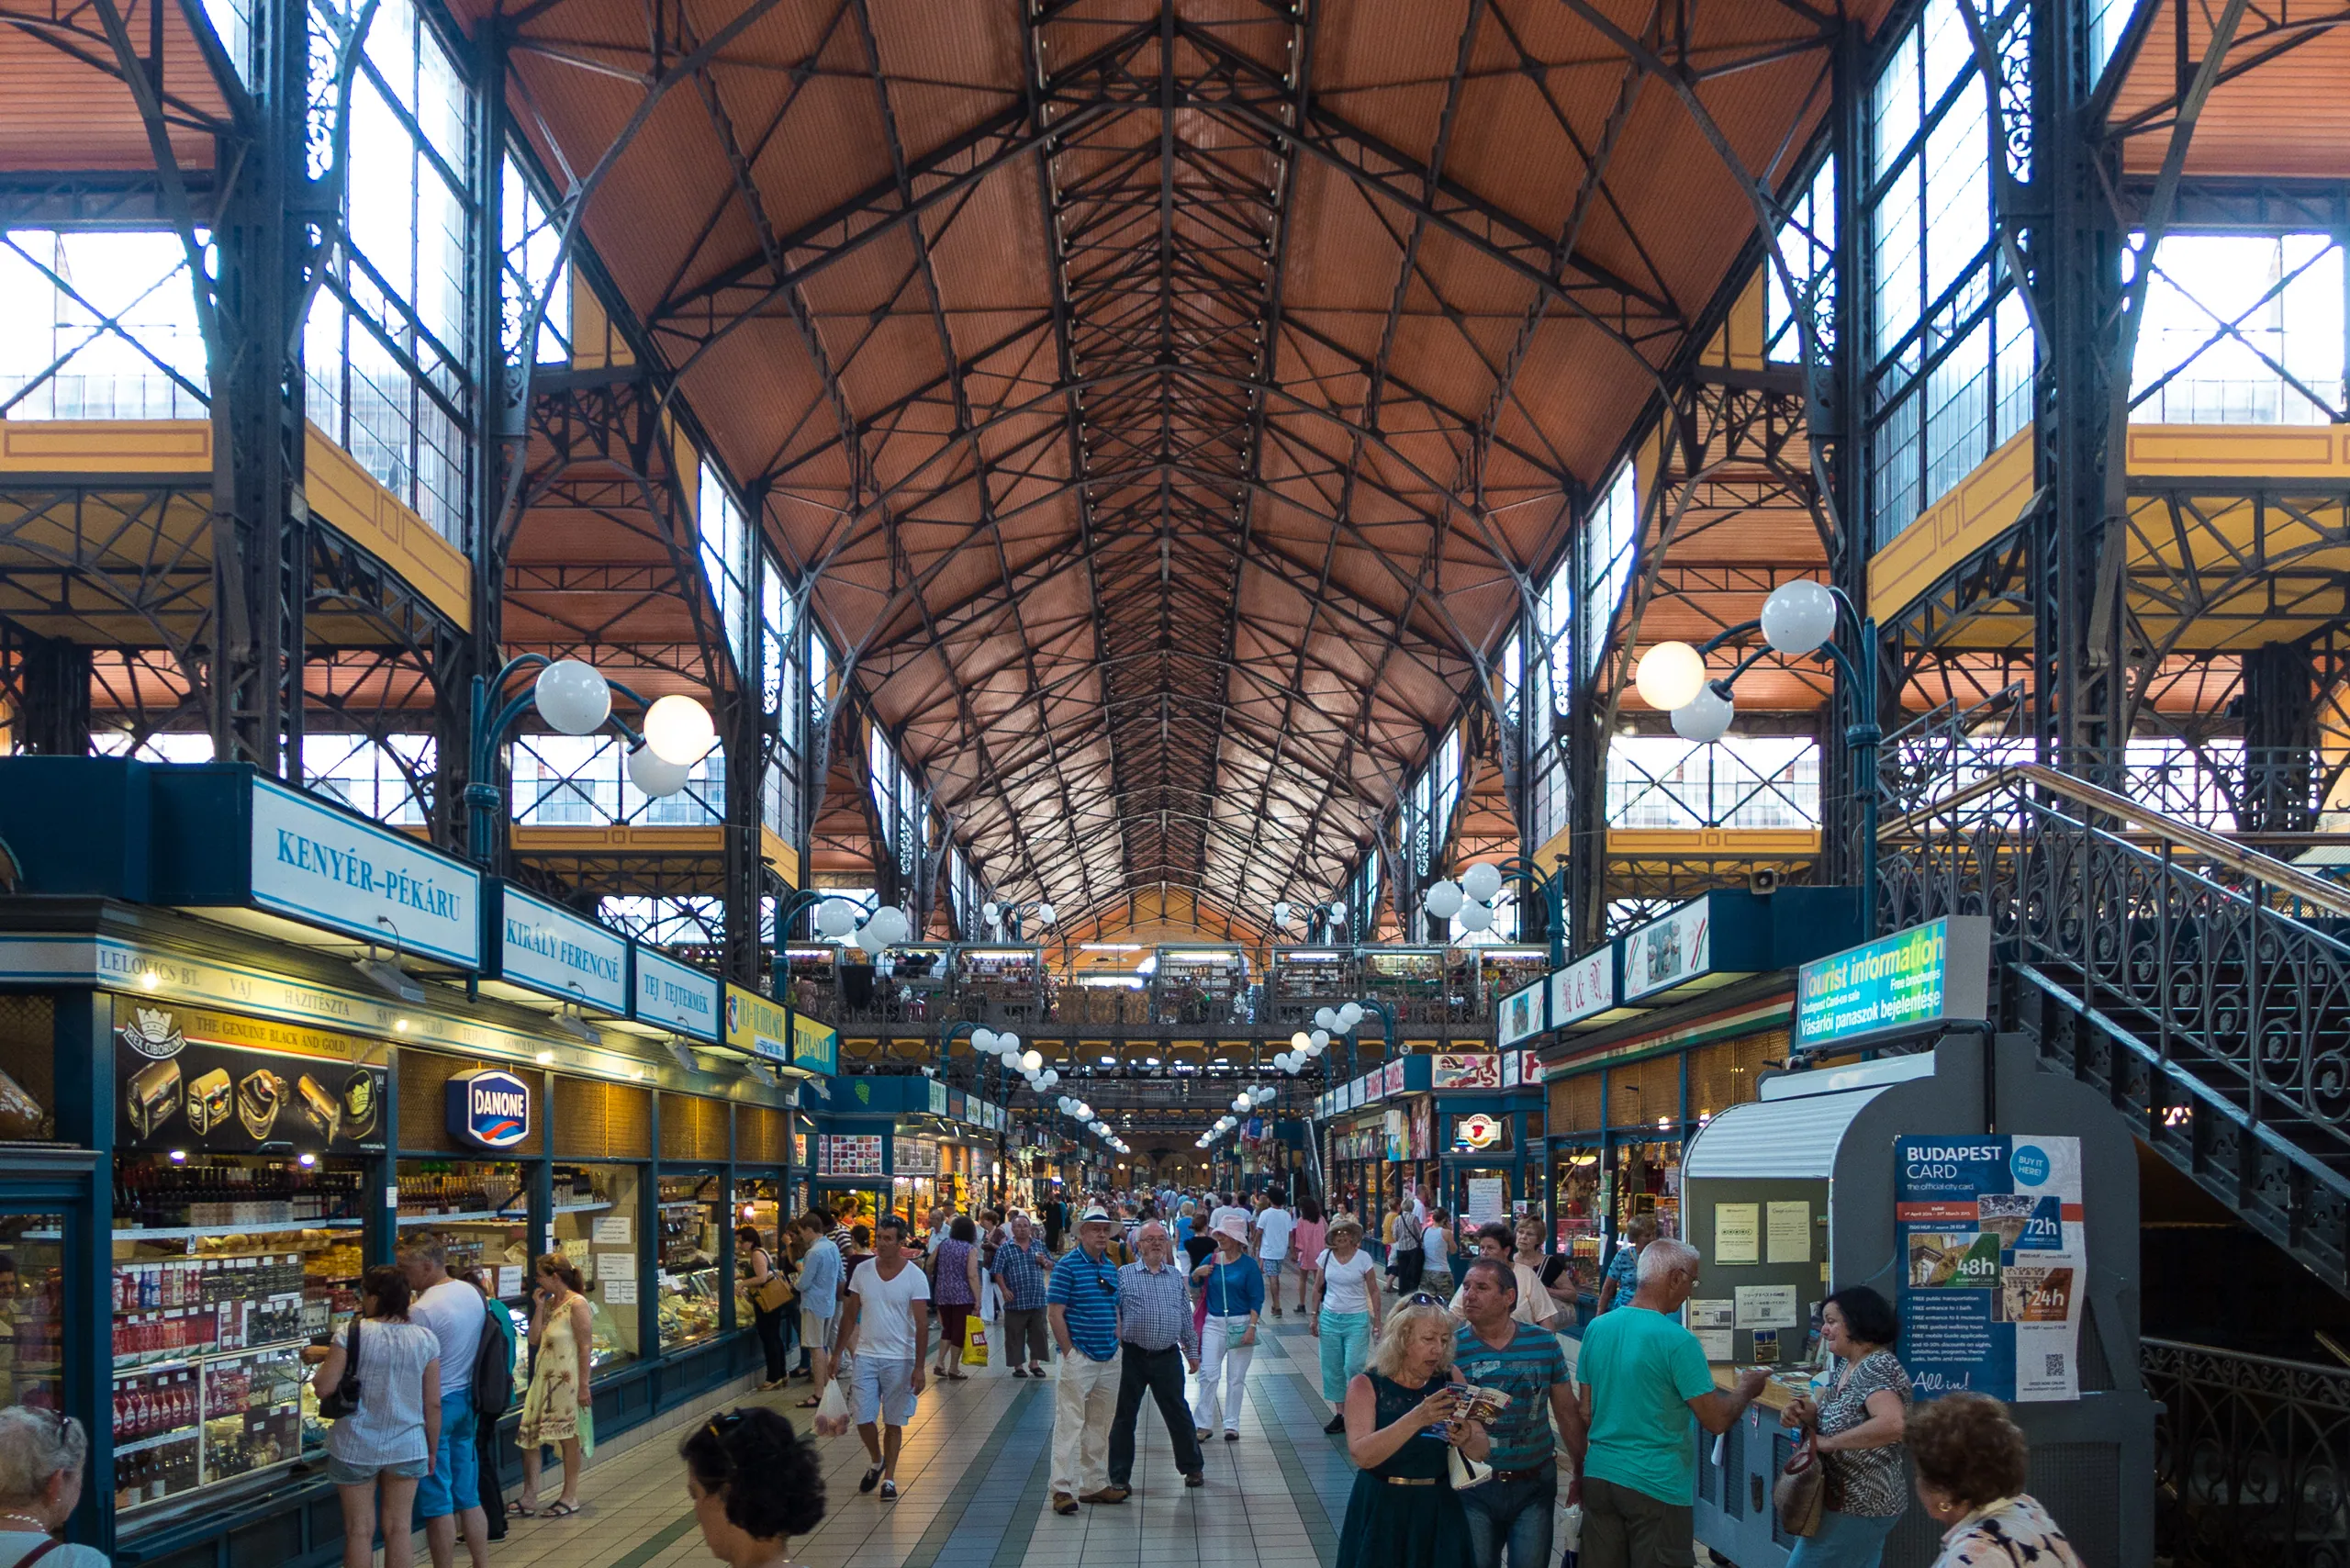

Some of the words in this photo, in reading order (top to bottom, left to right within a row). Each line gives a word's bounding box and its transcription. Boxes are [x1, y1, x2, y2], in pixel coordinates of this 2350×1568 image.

[506, 917, 557, 959] KIRÁLY
[561, 940, 619, 984] FERENCNÉ
[1802, 959, 1847, 999] Tourist
[1850, 935, 1944, 986] information
[229, 977, 252, 1000] VAJ
[1890, 977, 1906, 991] Free
[1906, 969, 1941, 989] brochures
[644, 973, 660, 1002] TEJ
[664, 980, 709, 1014] TEJTERMÉK
[1801, 1000, 1825, 1014] Budapest
[1848, 989, 1861, 1002] sale
[1801, 1013, 1833, 1036] Vásárlói
[1835, 1000, 1879, 1033] panaszok
[1880, 988, 1941, 1021] bejelentése
[128, 1029, 143, 1049] REX
[144, 1035, 183, 1055] CIBORUM
[196, 1016, 221, 1033] THE
[222, 1022, 265, 1041] GENUINE
[269, 1027, 298, 1046] BLACK
[301, 1034, 319, 1048] AND
[321, 1037, 346, 1053] GOLD
[475, 1088, 524, 1118] DANONE
[1907, 1147, 2002, 1161] BUDAPEST
[2018, 1155, 2035, 1165] BUY
[1907, 1164, 1957, 1179] CARD
[2018, 1165, 2042, 1177] HERE!
[1907, 1182, 1919, 1191] the
[1919, 1182, 1943, 1191] official
[1944, 1182, 1958, 1192] city
[2025, 1216, 2058, 1236] 72h
[1956, 1257, 1995, 1275] 48h
[2031, 1288, 2065, 1306] 24h
[1912, 1371, 1944, 1392] All
[1946, 1371, 1970, 1390] in!
